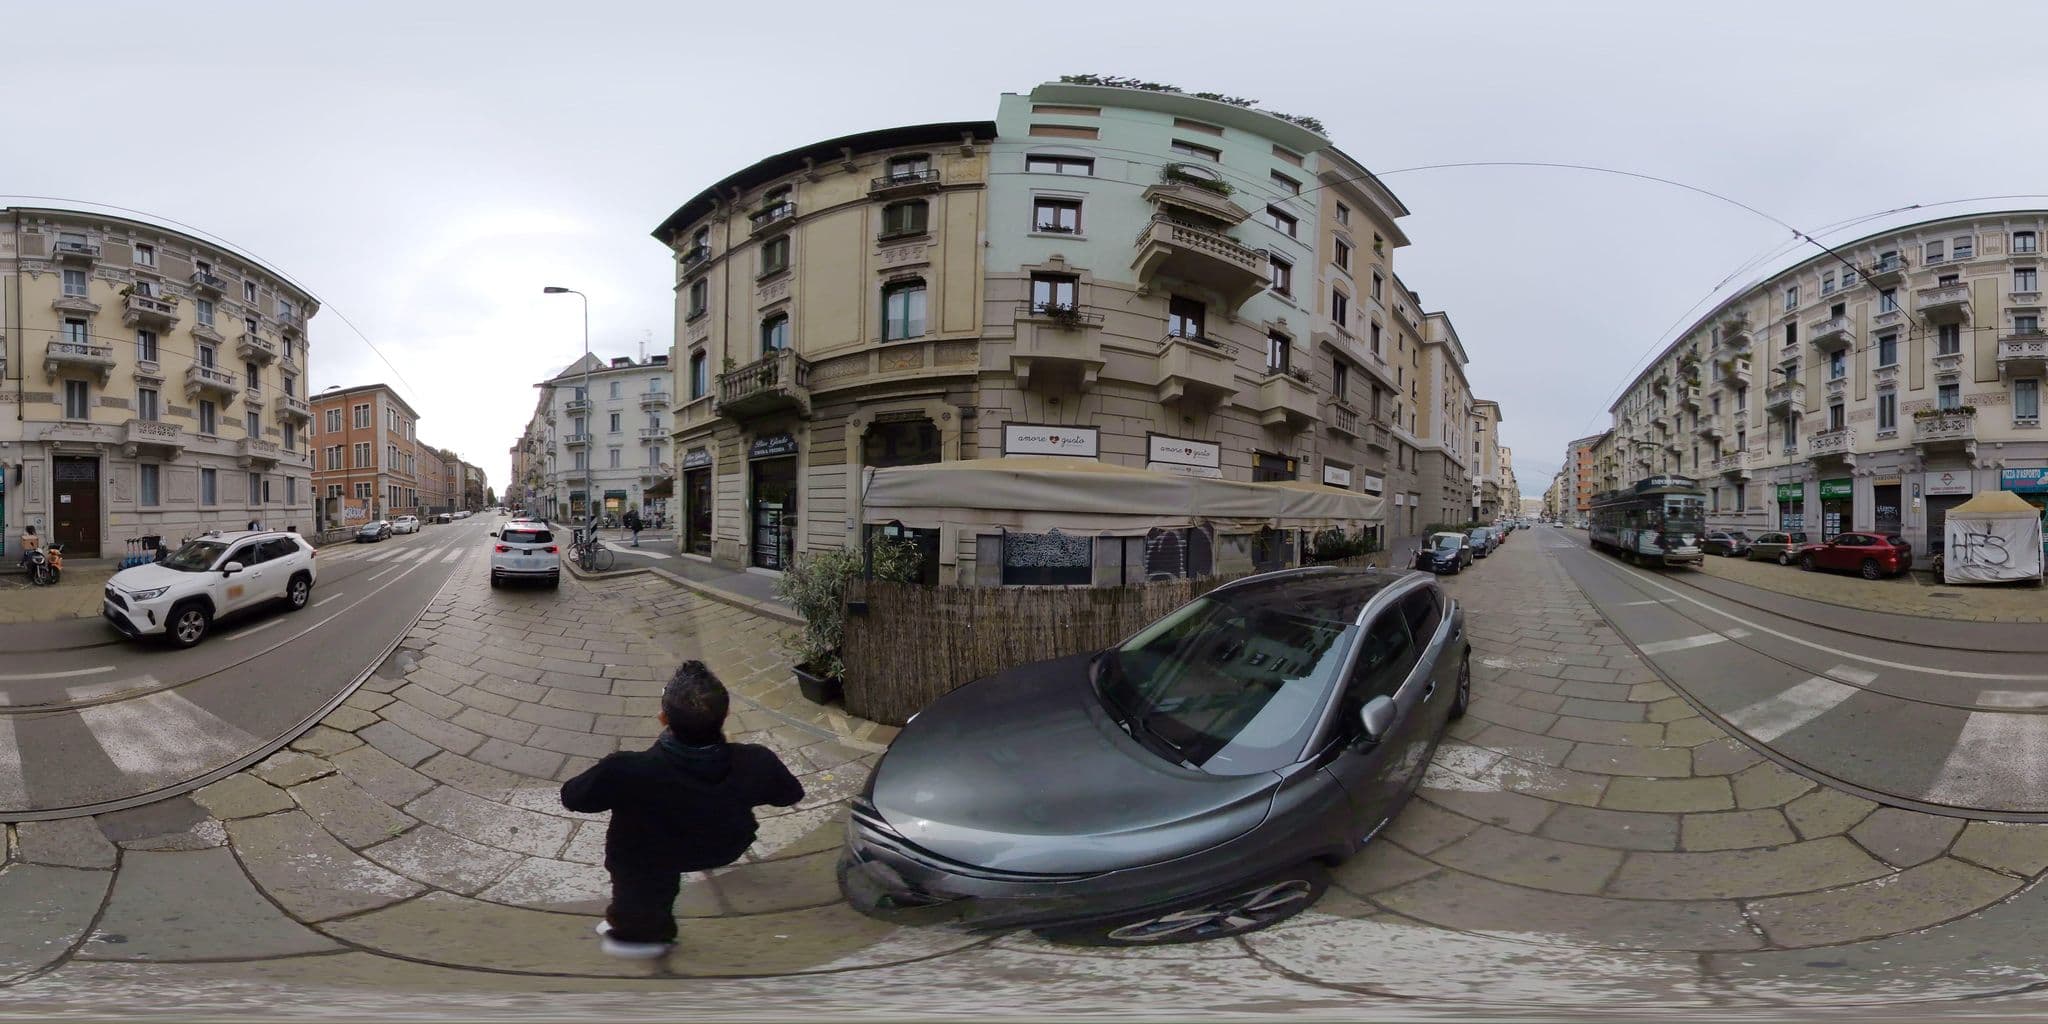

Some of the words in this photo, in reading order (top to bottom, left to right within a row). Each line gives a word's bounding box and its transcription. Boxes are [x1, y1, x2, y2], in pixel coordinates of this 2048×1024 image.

[1061, 435, 1085, 448] gusto
[1160, 446, 1183, 454] amore
[2002, 469, 2015, 478] PIZZA
